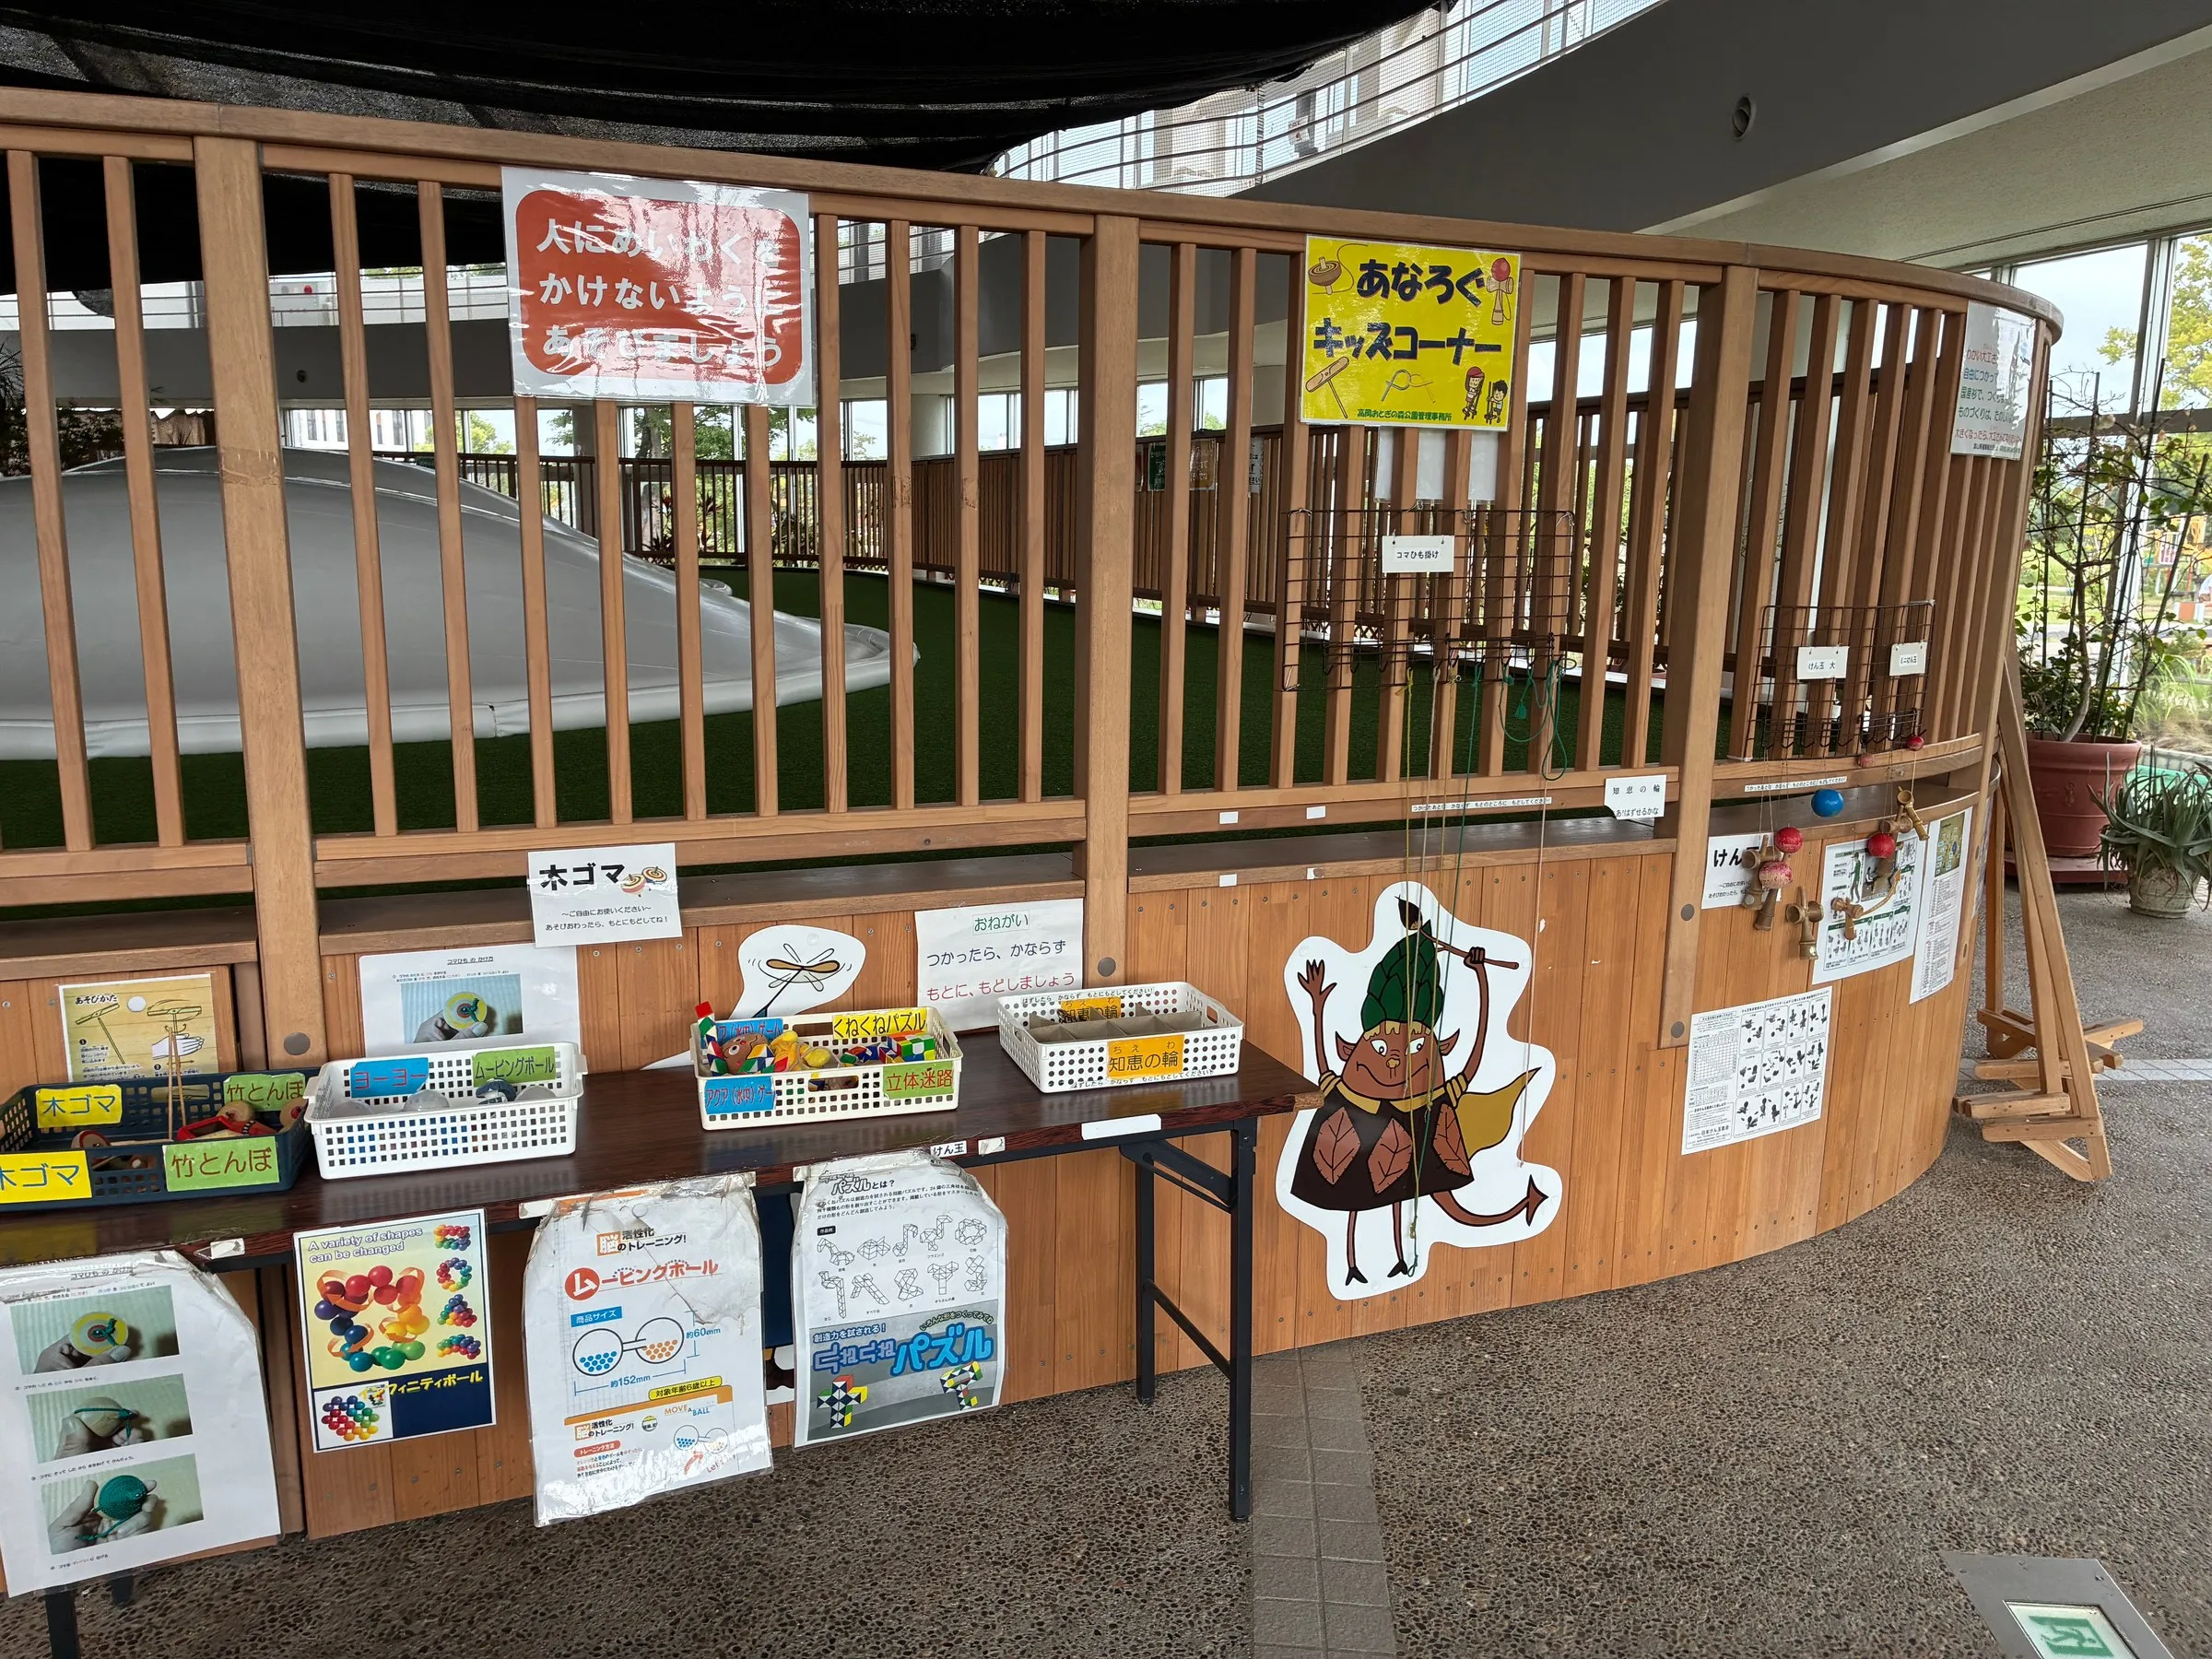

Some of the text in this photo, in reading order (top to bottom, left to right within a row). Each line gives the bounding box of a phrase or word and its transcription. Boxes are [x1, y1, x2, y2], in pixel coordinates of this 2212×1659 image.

[1356, 258, 1487, 308] あなろぐ
[1312, 317, 1502, 366] キッズコーナー
[1357, 407, 1453, 422] 高岡おとぎの森公園管理事務所
[1396, 549, 1440, 559] コマひも掛け
[1808, 661, 1836, 671] けん玉 大
[1713, 845, 1759, 868] けん
[538, 862, 626, 891] 木ゴマ
[974, 913, 1030, 933] おねがい
[926, 972, 1077, 1002] もとに、もどしましょう
[75, 993, 120, 1006] あそびかた
[1021, 995, 1053, 1006] はずしたら
[833, 1011, 927, 1039] くねくねパズル
[474, 1055, 555, 1080] ムービングボール
[1108, 1051, 1180, 1074] 知恵の輪
[227, 1078, 305, 1102] 竹とんぼ
[354, 1068, 427, 1090] ヨーヨー
[886, 1067, 954, 1092] 立体迷路
[41, 1093, 116, 1118] 木ゴマ
[932, 1143, 965, 1156] けん玉
[170, 1146, 273, 1179] 竹とんぼ
[308, 1227, 424, 1252] A variety of shapes
[621, 1227, 655, 1241] 活性化
[309, 1241, 406, 1264] can be changed
[571, 1259, 720, 1298] ムービングボール
[575, 1309, 618, 1324] 商品サイズ
[686, 1327, 722, 1339] 約60mm
[813, 1323, 887, 1344] 創造力を試される！
[610, 1374, 651, 1389] 約152mm
[655, 1379, 716, 1398] 対象年齢6歳以上
[664, 1404, 688, 1416] MOVE
[692, 1406, 711, 1417] BALL
[591, 1418, 613, 1430] 活性化
